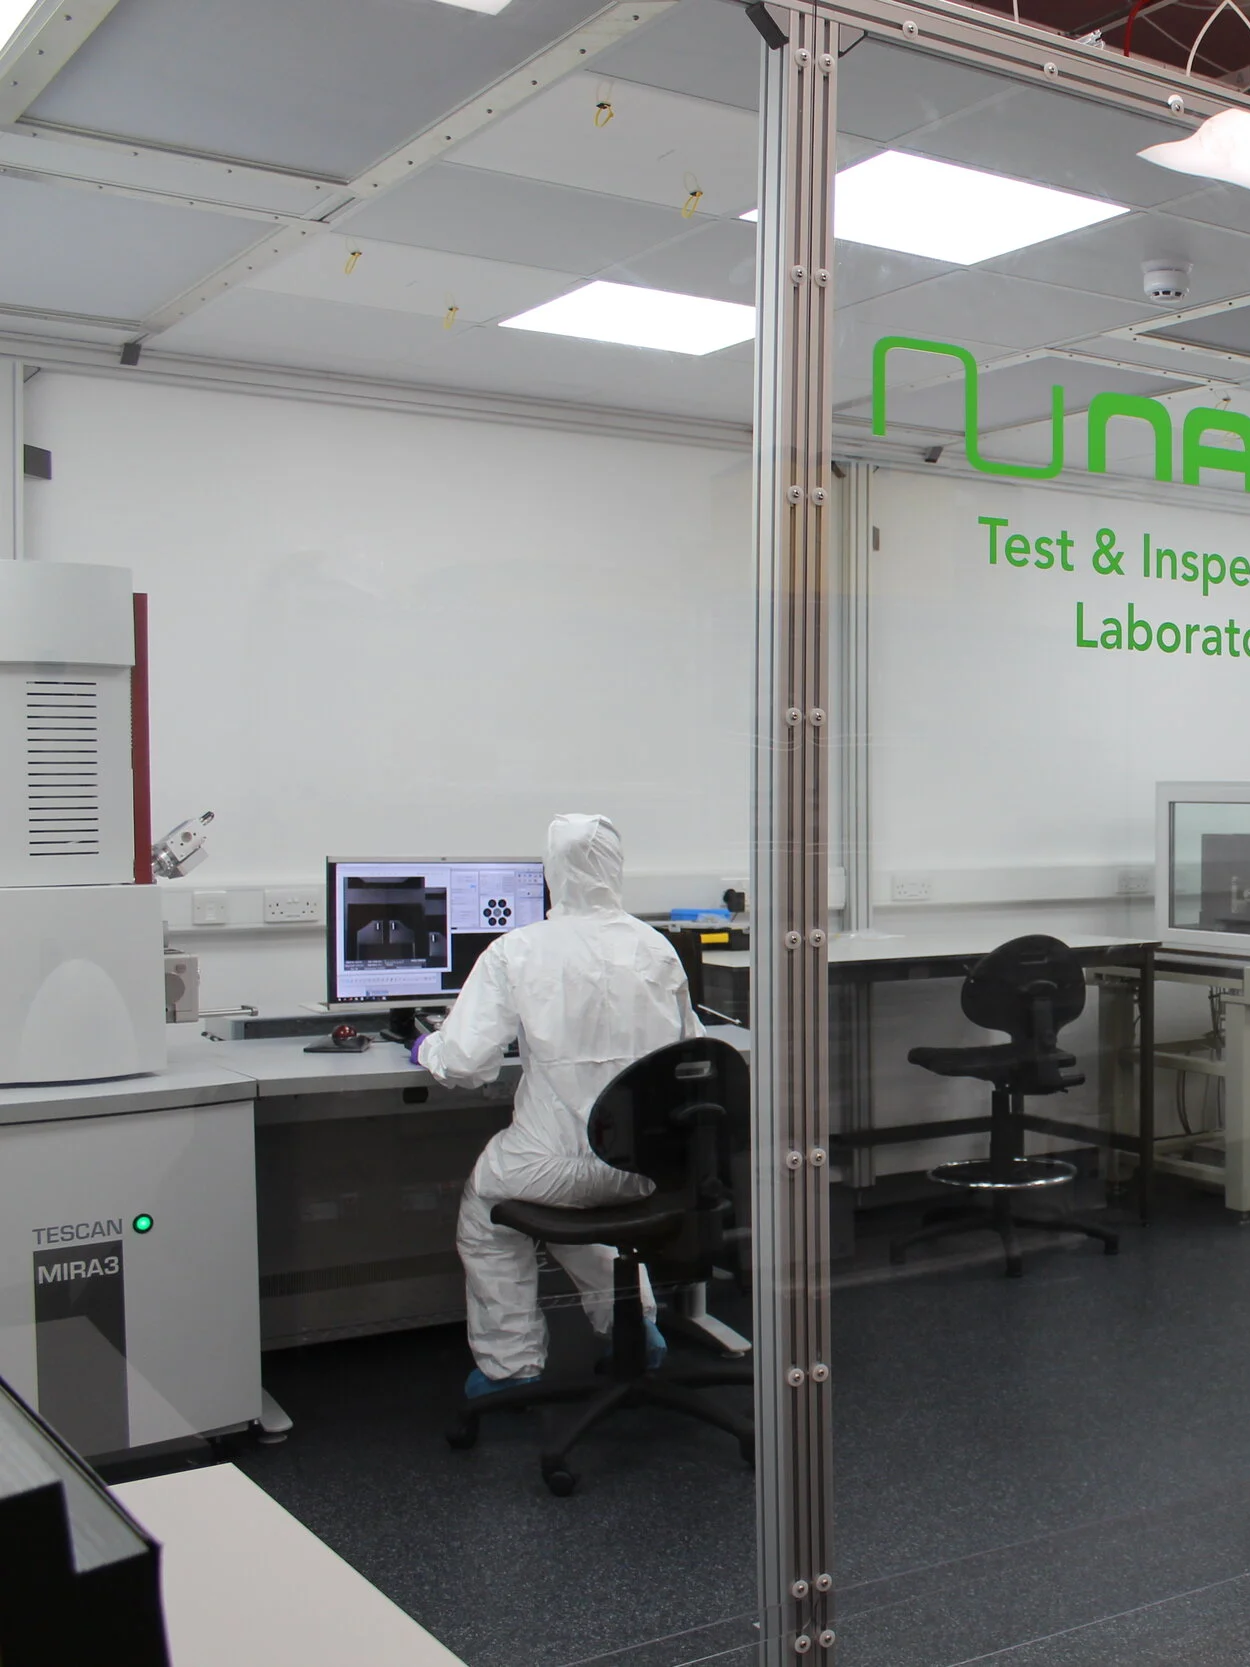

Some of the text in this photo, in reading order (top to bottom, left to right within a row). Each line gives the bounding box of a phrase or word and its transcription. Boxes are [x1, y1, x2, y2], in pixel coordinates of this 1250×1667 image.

[978, 516, 1074, 572] Test
[1092, 528, 1125, 575] &
[32, 1218, 123, 1245] TESCAN
[38, 1256, 119, 1285] MIRA3
